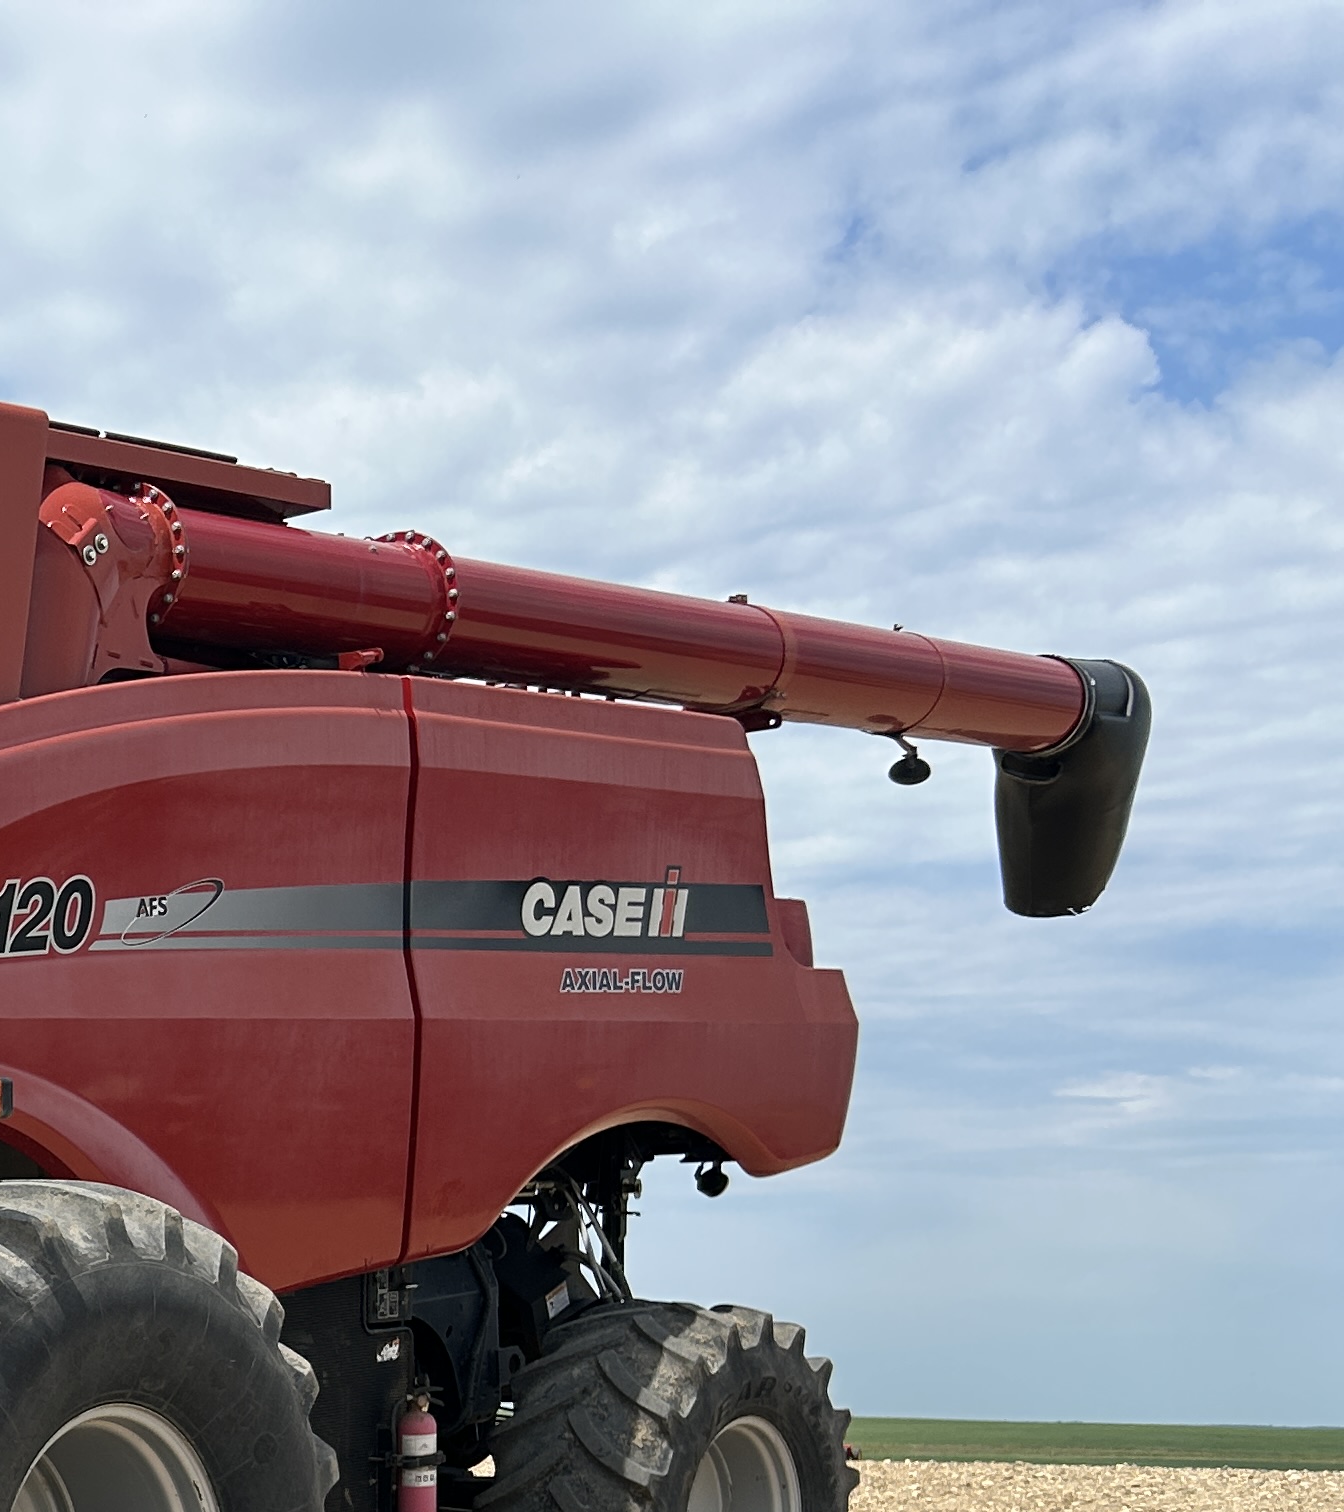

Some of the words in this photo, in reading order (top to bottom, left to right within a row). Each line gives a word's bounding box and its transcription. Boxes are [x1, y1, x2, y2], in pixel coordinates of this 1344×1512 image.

[135, 896, 168, 918] AFS
[521, 881, 646, 938] CASE
[560, 968, 684, 993] AXIAL-FLOW
